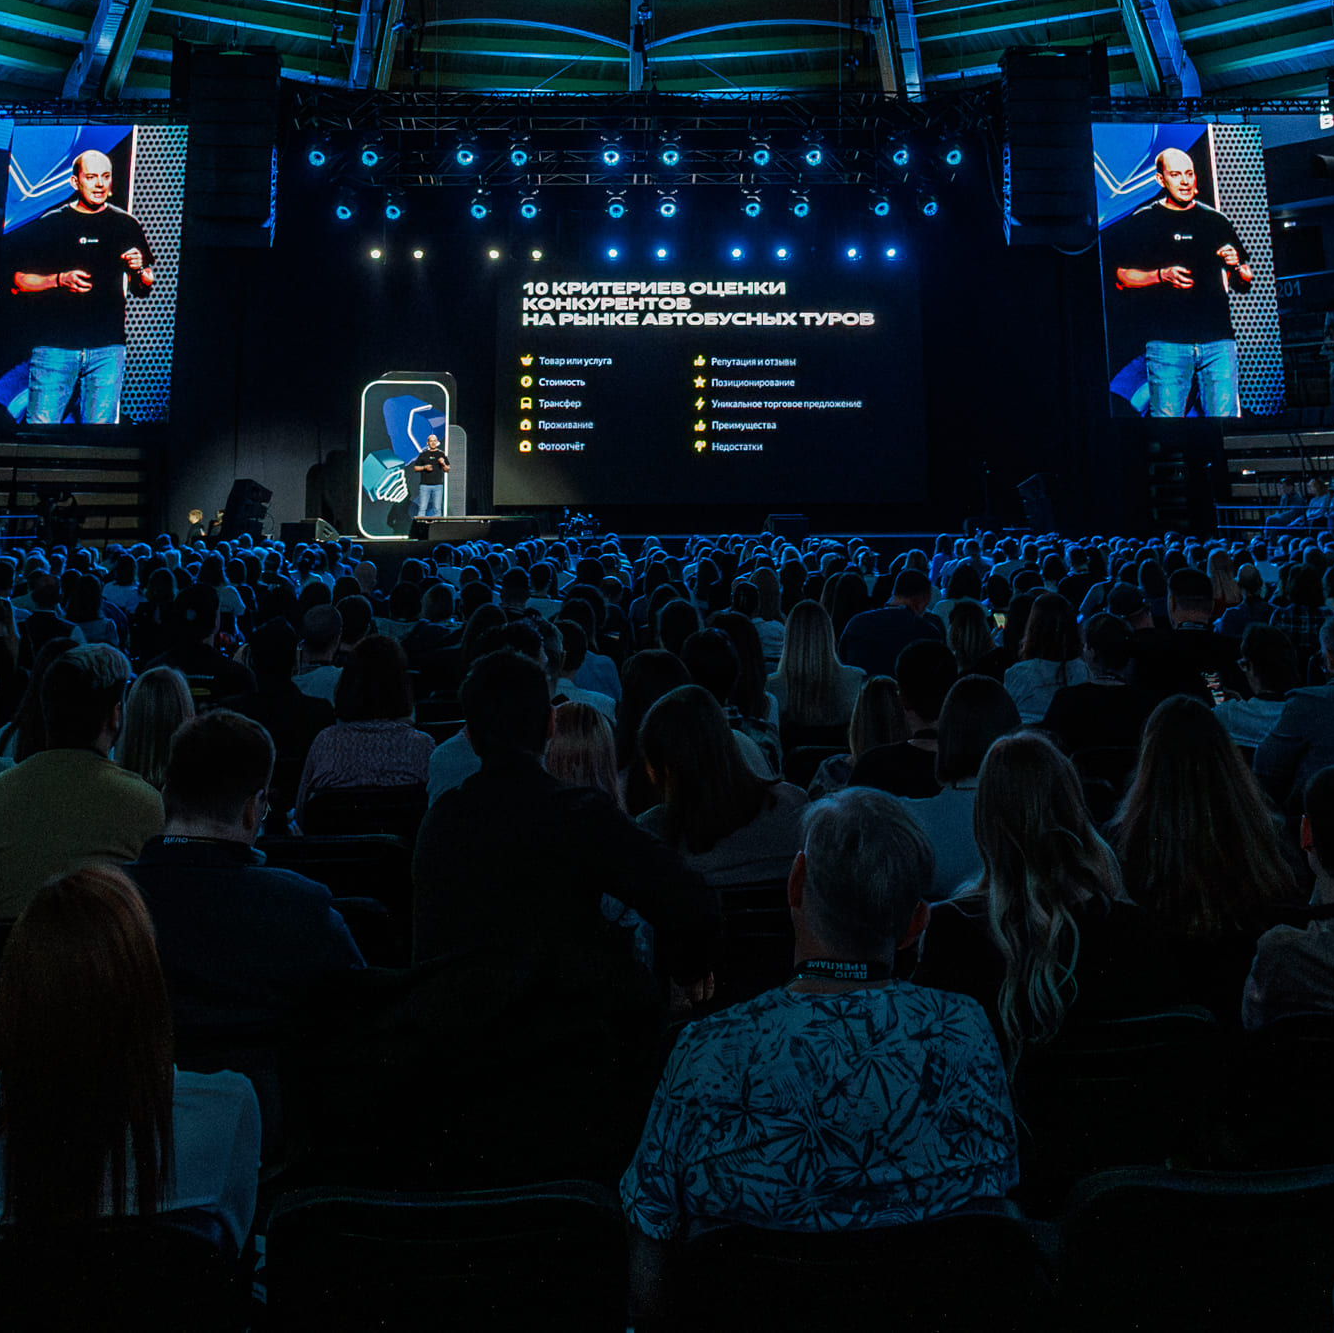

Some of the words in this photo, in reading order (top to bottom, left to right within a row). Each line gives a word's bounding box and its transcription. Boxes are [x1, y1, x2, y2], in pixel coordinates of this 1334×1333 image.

[1320, 113, 1334, 130] В
[523, 282, 548, 295] 10
[552, 282, 686, 295] КРИТЕРИЕВ
[688, 282, 786, 297] ОЦЕНКИ
[523, 297, 691, 310] КОНКУРЕНТОВ
[523, 313, 555, 326] НА
[559, 313, 639, 325] РЫНКЕ
[642, 313, 797, 325] АВТОБУСНЫХ
[799, 312, 875, 326] ТУРОВ
[539, 357, 565, 366] Товар
[584, 358, 612, 366] услуга
[712, 358, 756, 367] Репутация
[539, 378, 585, 386] Стоимость
[712, 378, 794, 388] Позиционирование
[539, 399, 581, 409] Трансфер
[712, 400, 762, 408] Уникальное
[804, 401, 861, 409] предложение
[539, 421, 593, 430] Проживание
[712, 421, 776, 431] Преимущества
[538, 442, 584, 450] Фотоотчёт
[712, 443, 762, 451] Недостатки
